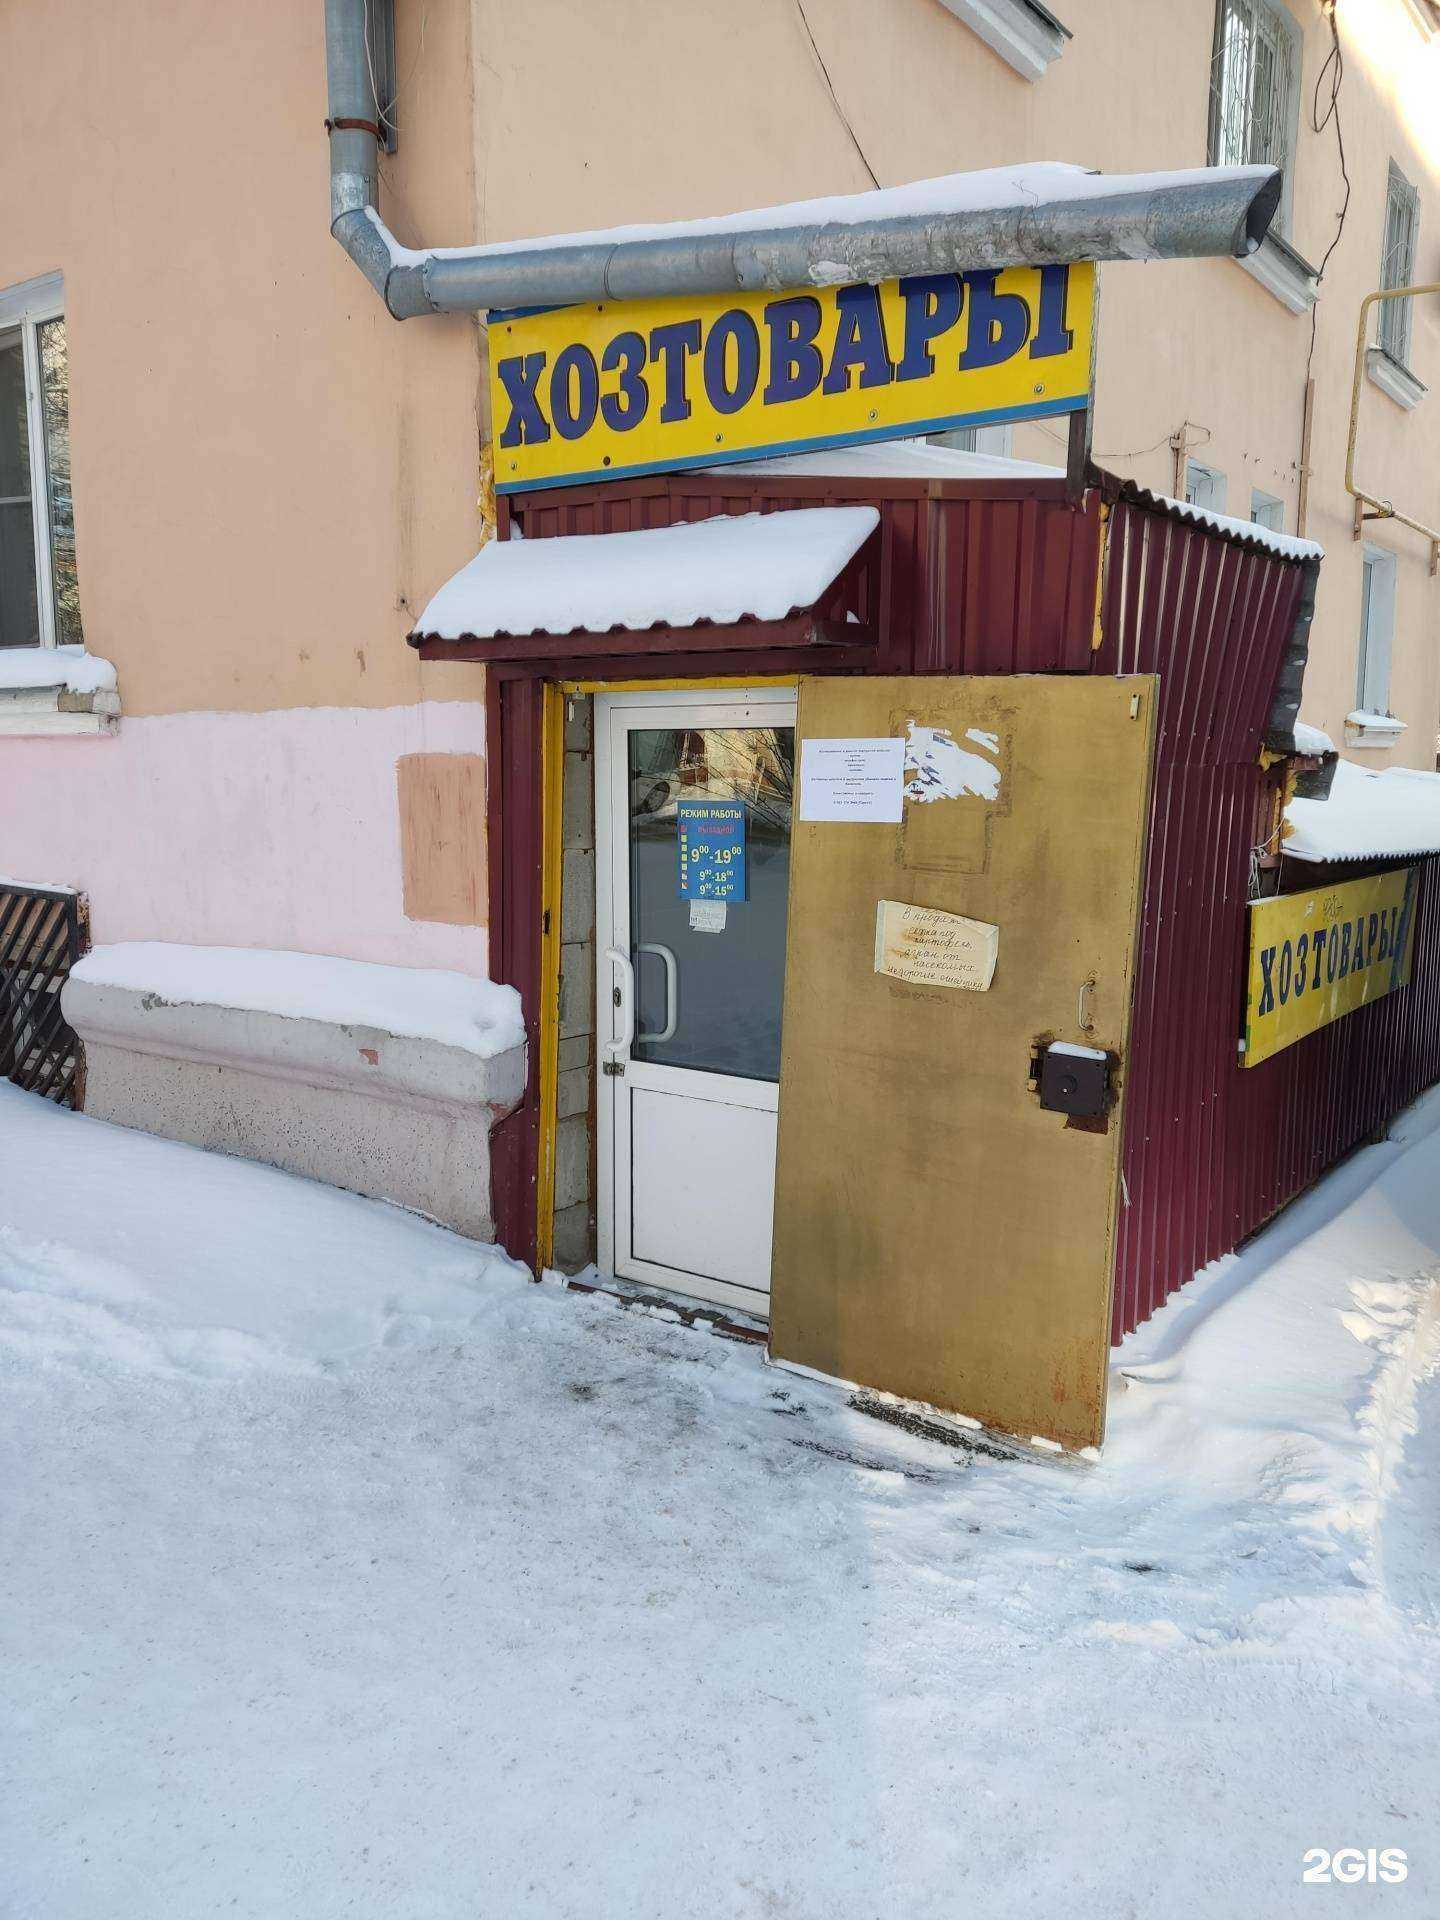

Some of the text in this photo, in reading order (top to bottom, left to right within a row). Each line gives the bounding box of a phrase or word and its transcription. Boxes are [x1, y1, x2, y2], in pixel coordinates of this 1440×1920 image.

[500, 265, 1073, 448] ХОЗТОВАРЫ
[681, 809, 742, 819] РЕЖИМ РАБОТЫ
[1258, 906, 1398, 1017] ХОЗТОВАРЫ
